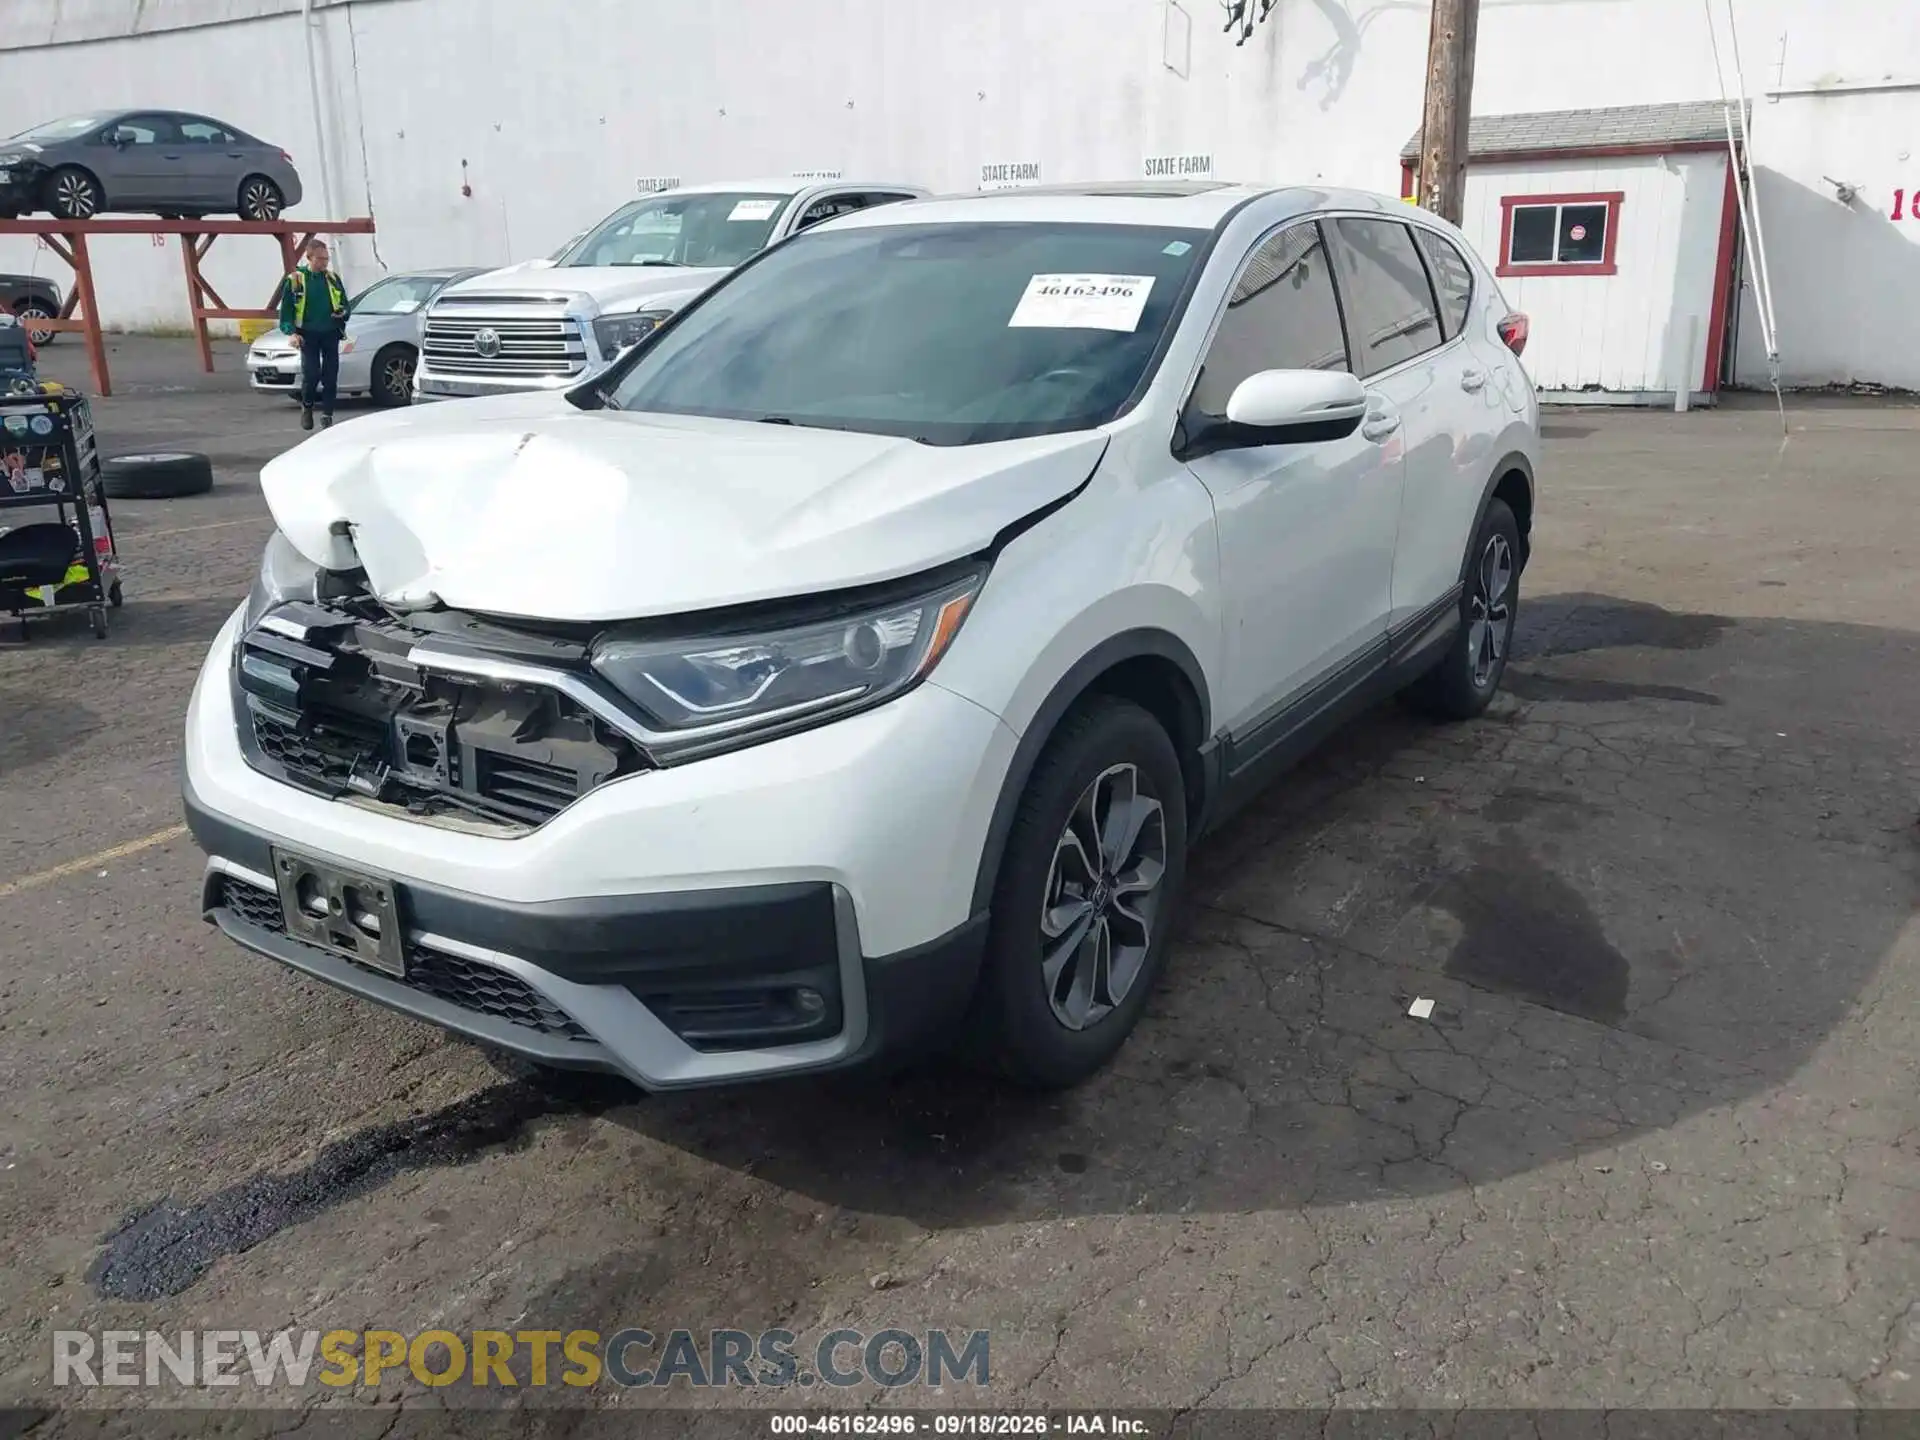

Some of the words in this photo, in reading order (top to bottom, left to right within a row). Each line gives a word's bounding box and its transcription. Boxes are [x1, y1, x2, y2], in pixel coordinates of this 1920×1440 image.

[982, 164, 1008, 182] STATE
[1010, 163, 1039, 181] FARM
[1145, 157, 1177, 176] STATE
[1179, 155, 1210, 174] FARM
[637, 178, 657, 193] STATE
[1036, 285, 1134, 297] 46162496
